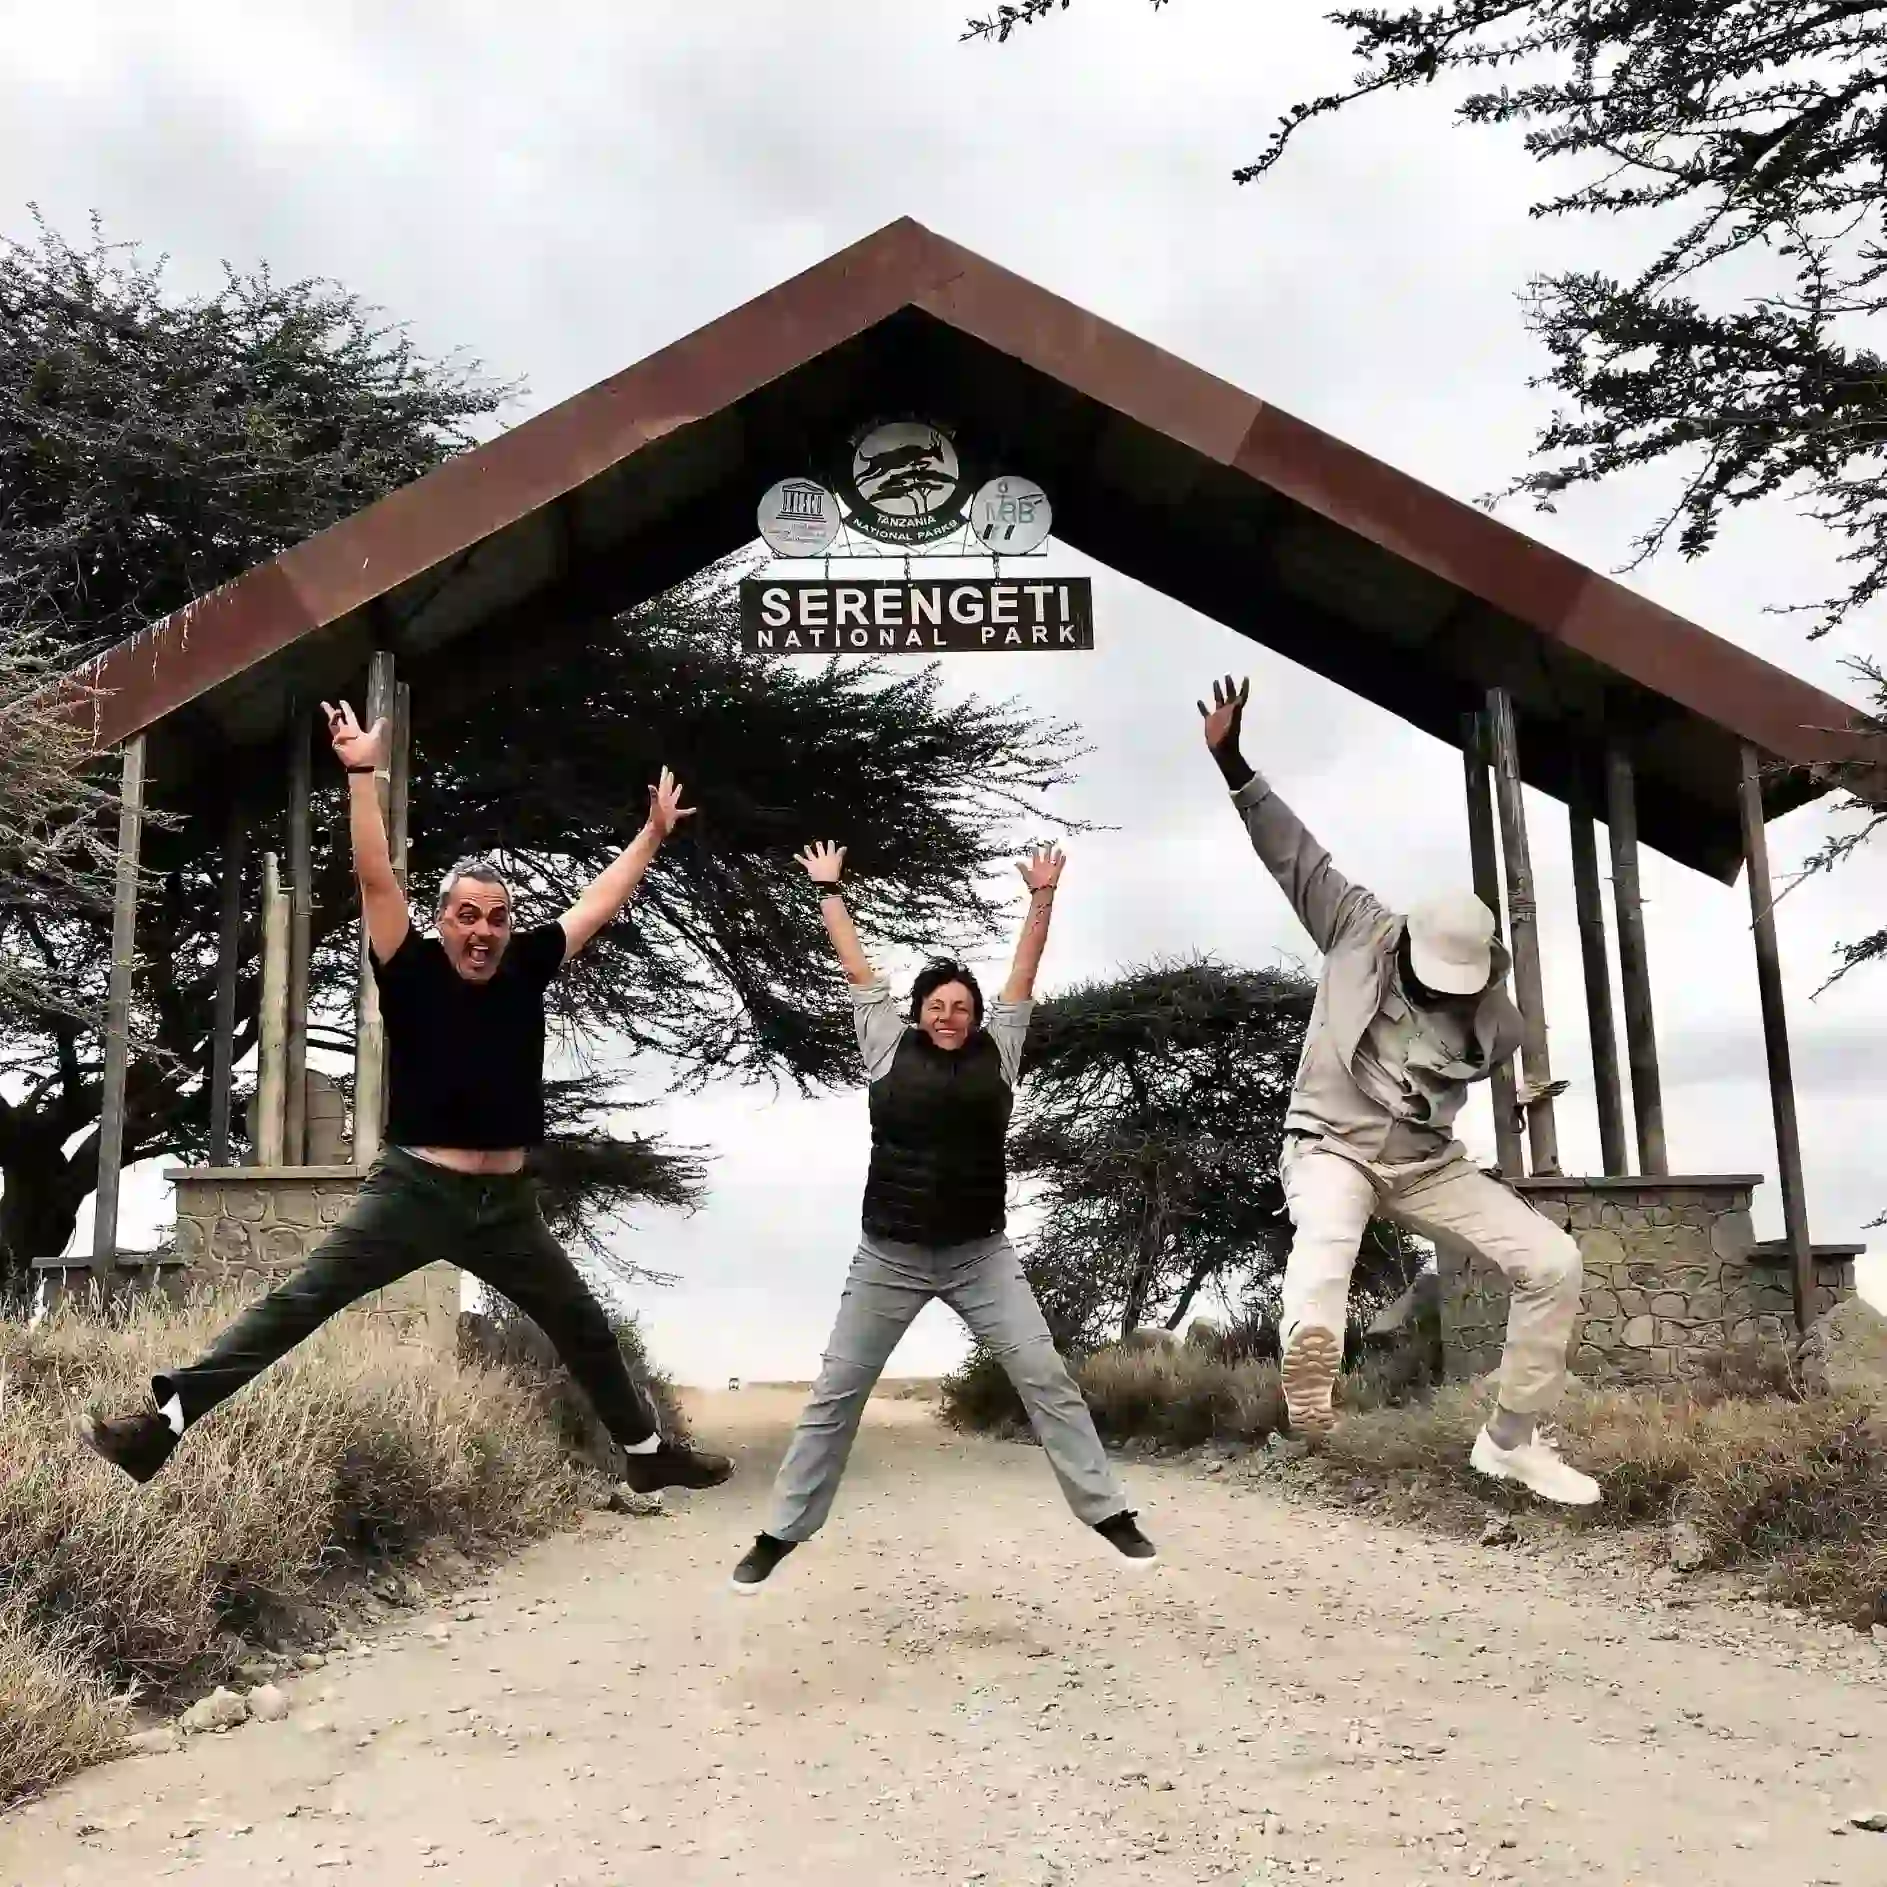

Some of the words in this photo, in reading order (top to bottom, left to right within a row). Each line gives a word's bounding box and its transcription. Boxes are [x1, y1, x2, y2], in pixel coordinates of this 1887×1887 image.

[852, 518, 914, 541] NATIONAL
[916, 519, 958, 540] PARKS
[876, 512, 937, 528] TANZANIA
[761, 585, 1070, 627] SERENGETI
[757, 628, 948, 648] NATIONAL
[981, 625, 1076, 646] PARK
